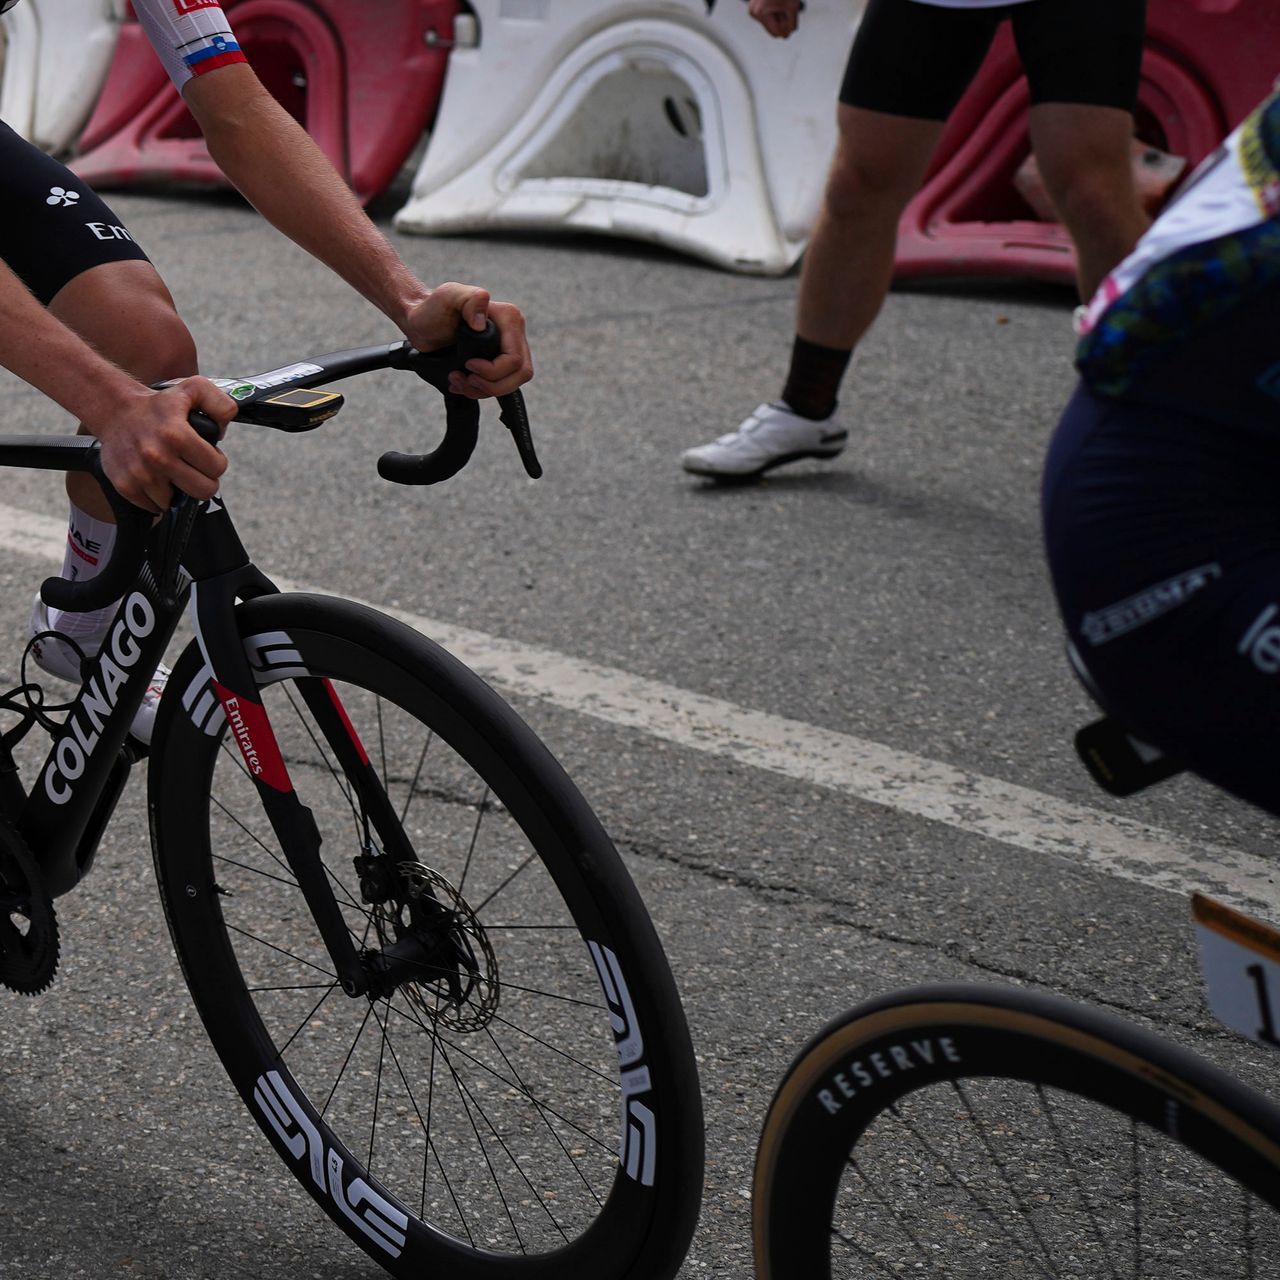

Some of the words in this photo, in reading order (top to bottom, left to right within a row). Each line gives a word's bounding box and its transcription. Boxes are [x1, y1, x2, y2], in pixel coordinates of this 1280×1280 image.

[44, 591, 156, 806] COLNAGO
[225, 696, 264, 777] Emirates
[816, 1036, 962, 1115] RESERVE
